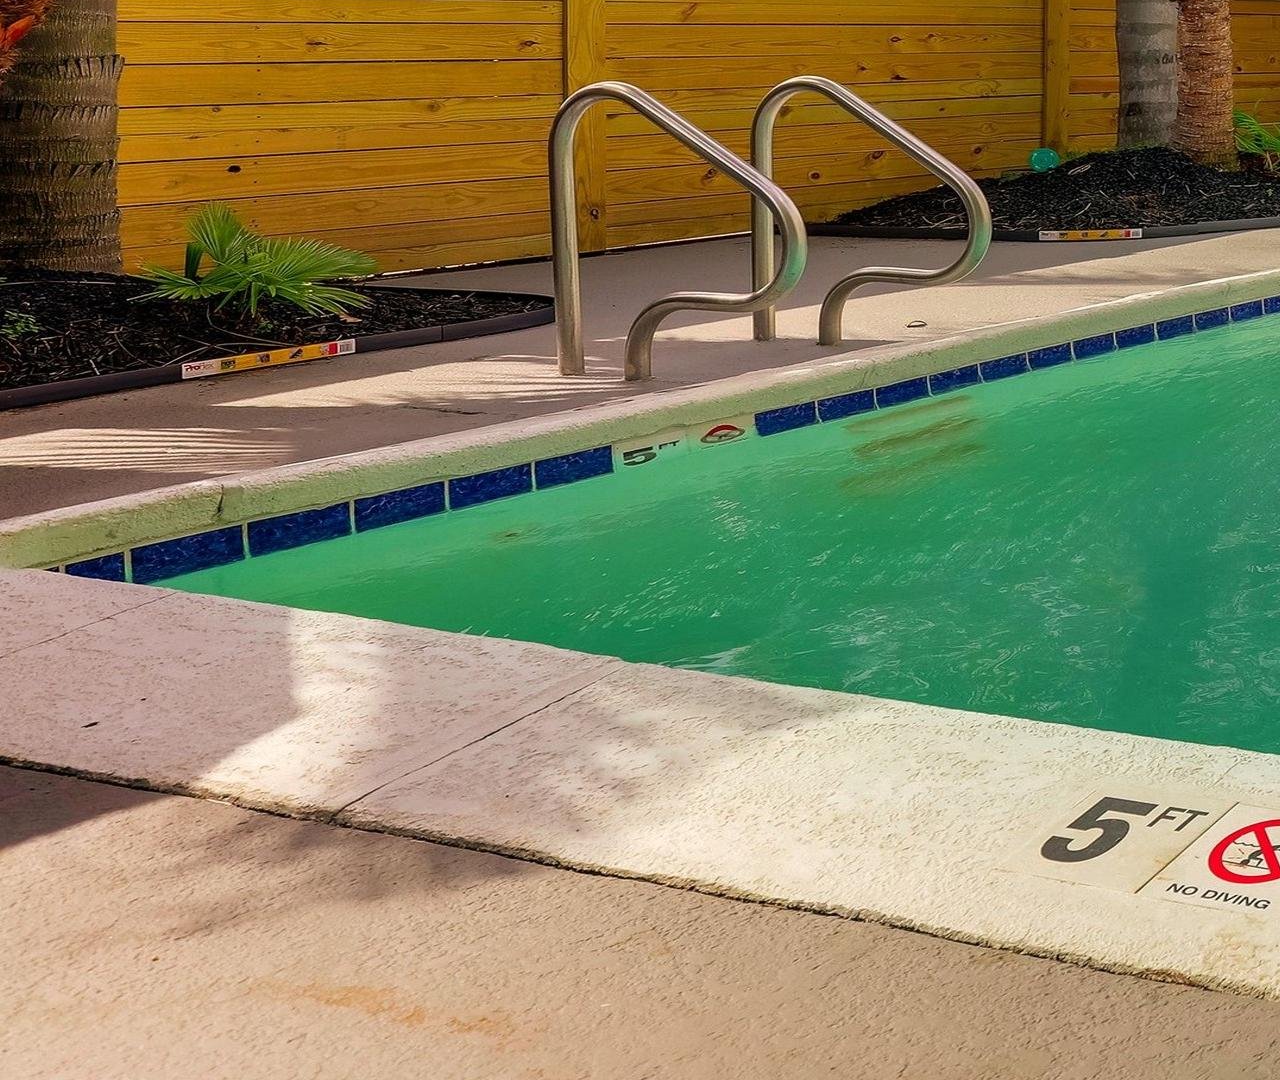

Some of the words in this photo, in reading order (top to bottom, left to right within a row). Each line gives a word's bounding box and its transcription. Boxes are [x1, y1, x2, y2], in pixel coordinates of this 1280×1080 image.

[622, 446, 657, 467] 5
[1040, 796, 1159, 863] 5
[1146, 806, 1210, 833] FT
[1166, 882, 1200, 897] NO
[1200, 888, 1272, 911] DIVING
